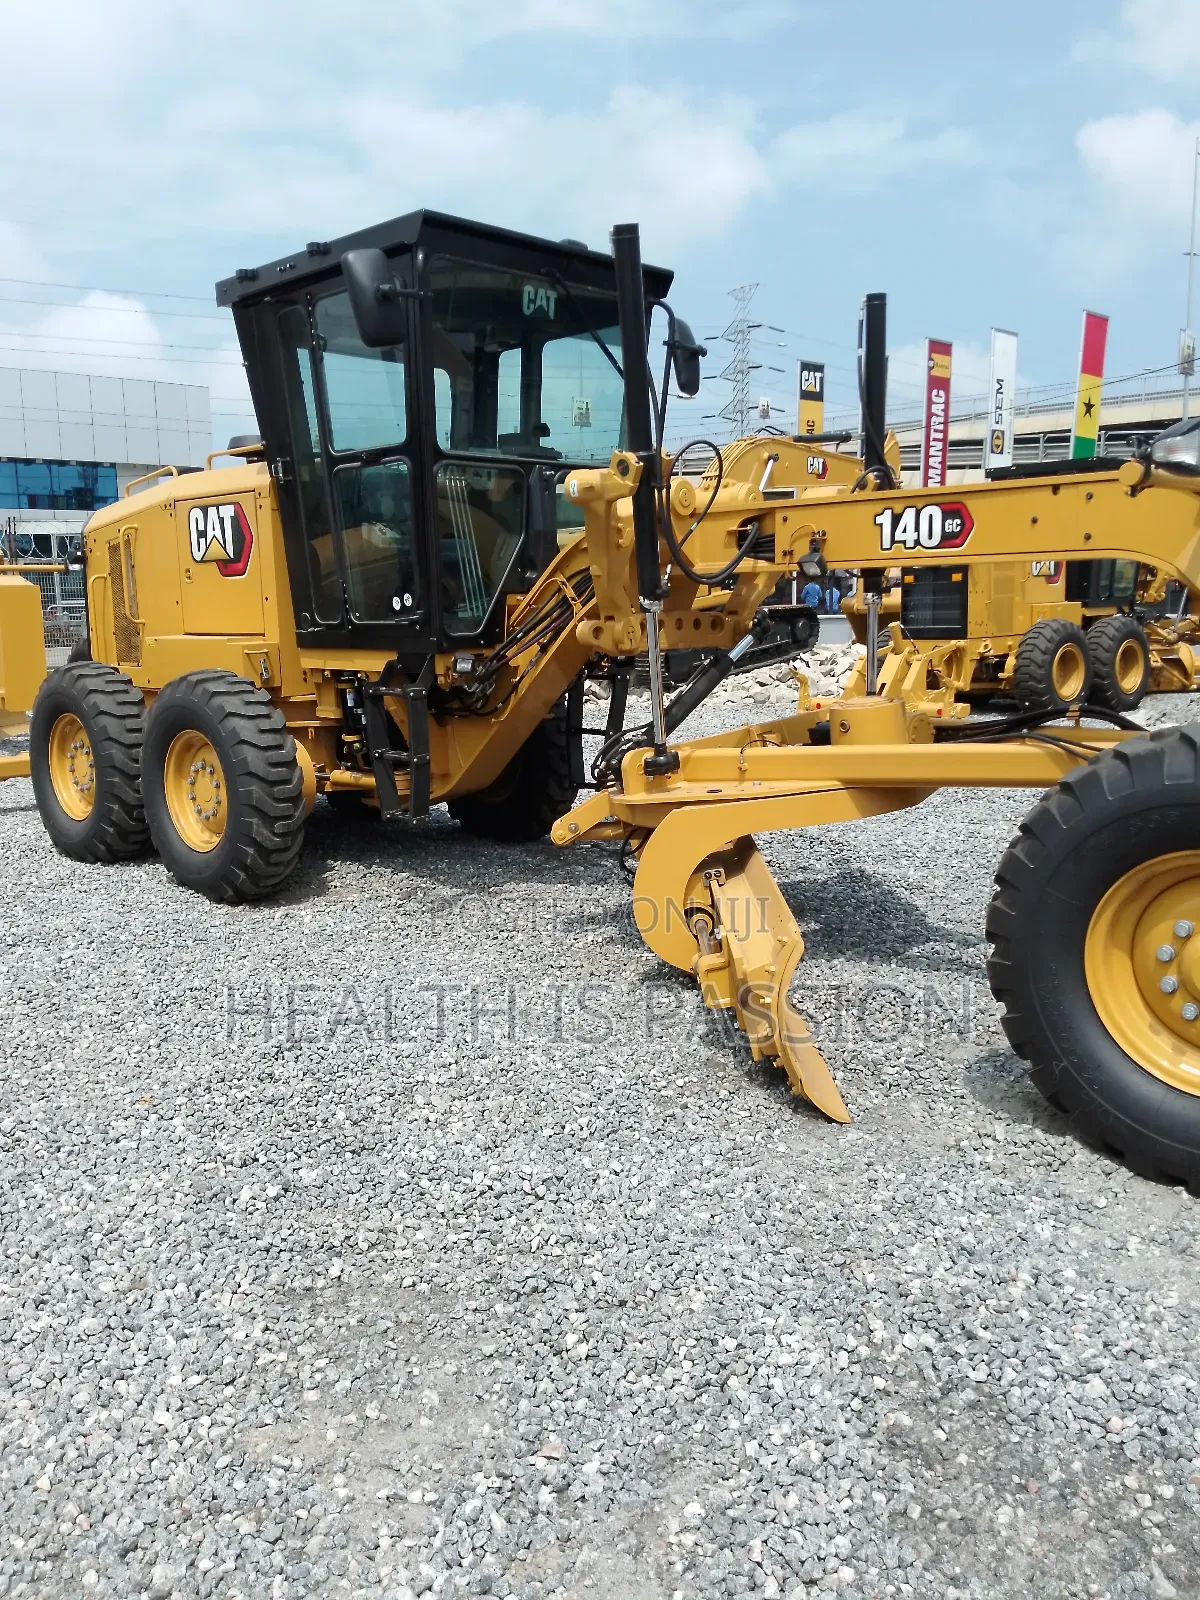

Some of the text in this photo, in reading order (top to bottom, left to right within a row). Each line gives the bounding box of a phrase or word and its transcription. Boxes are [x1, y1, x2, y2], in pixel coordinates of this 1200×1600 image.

[523, 285, 557, 320] CAT
[801, 371, 821, 393] CAT
[995, 378, 1004, 425] SEM
[928, 388, 945, 487] MANTRAC
[807, 456, 824, 475] CAT
[190, 504, 234, 561] CAT
[875, 505, 961, 549] 140 GC
